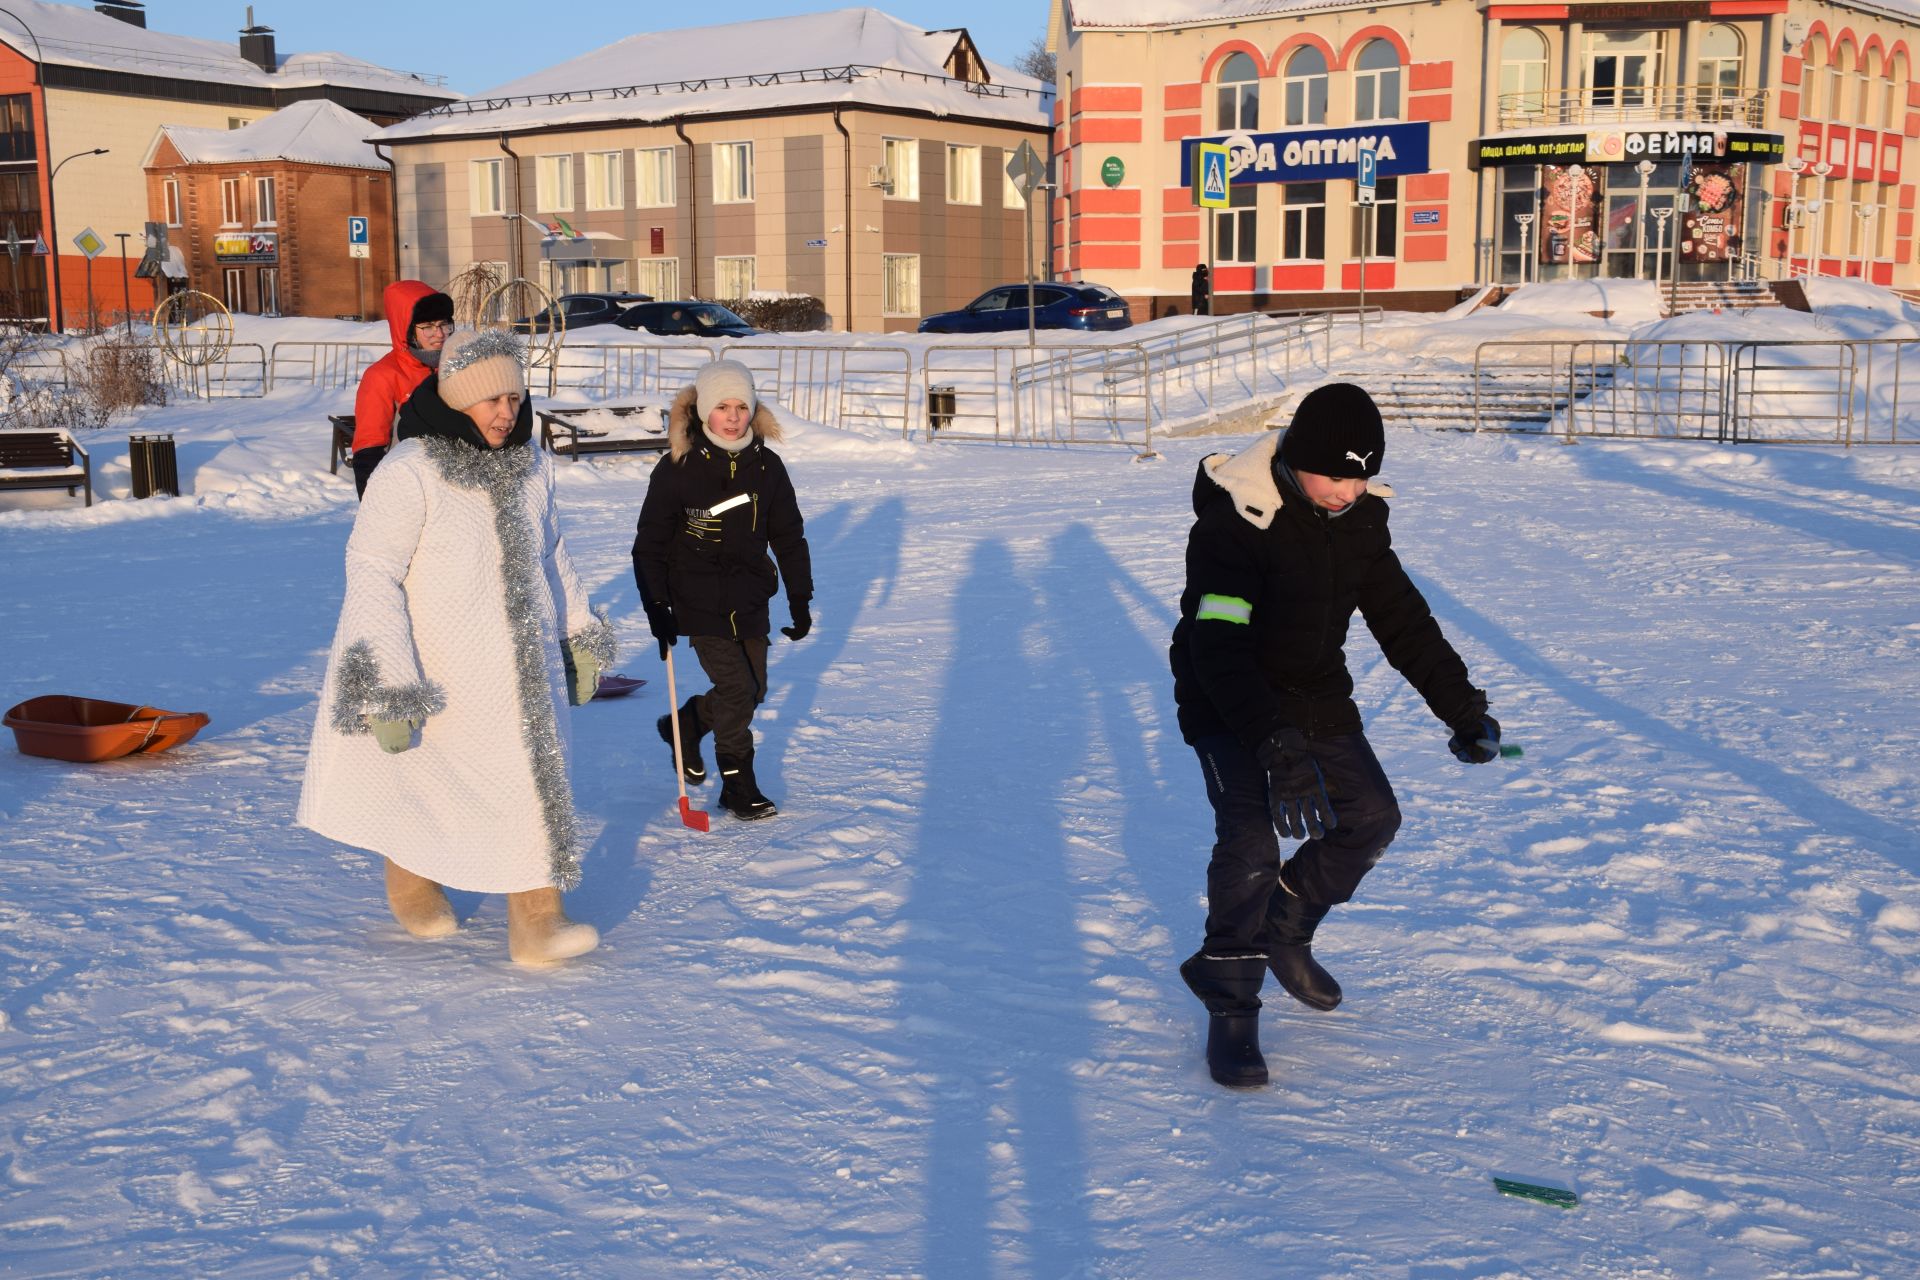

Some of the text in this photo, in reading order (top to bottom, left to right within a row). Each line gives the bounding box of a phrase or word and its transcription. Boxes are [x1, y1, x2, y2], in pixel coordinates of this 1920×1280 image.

[1283, 135, 1397, 167] ОПТИКА
[1481, 146, 1503, 158] ПИЦЦА
[1505, 144, 1537, 156] ШАУРМА
[1587, 131, 1713, 156] КОФЕЙНЯ
[1362, 153, 1373, 183] P
[352, 219, 364, 241] P
